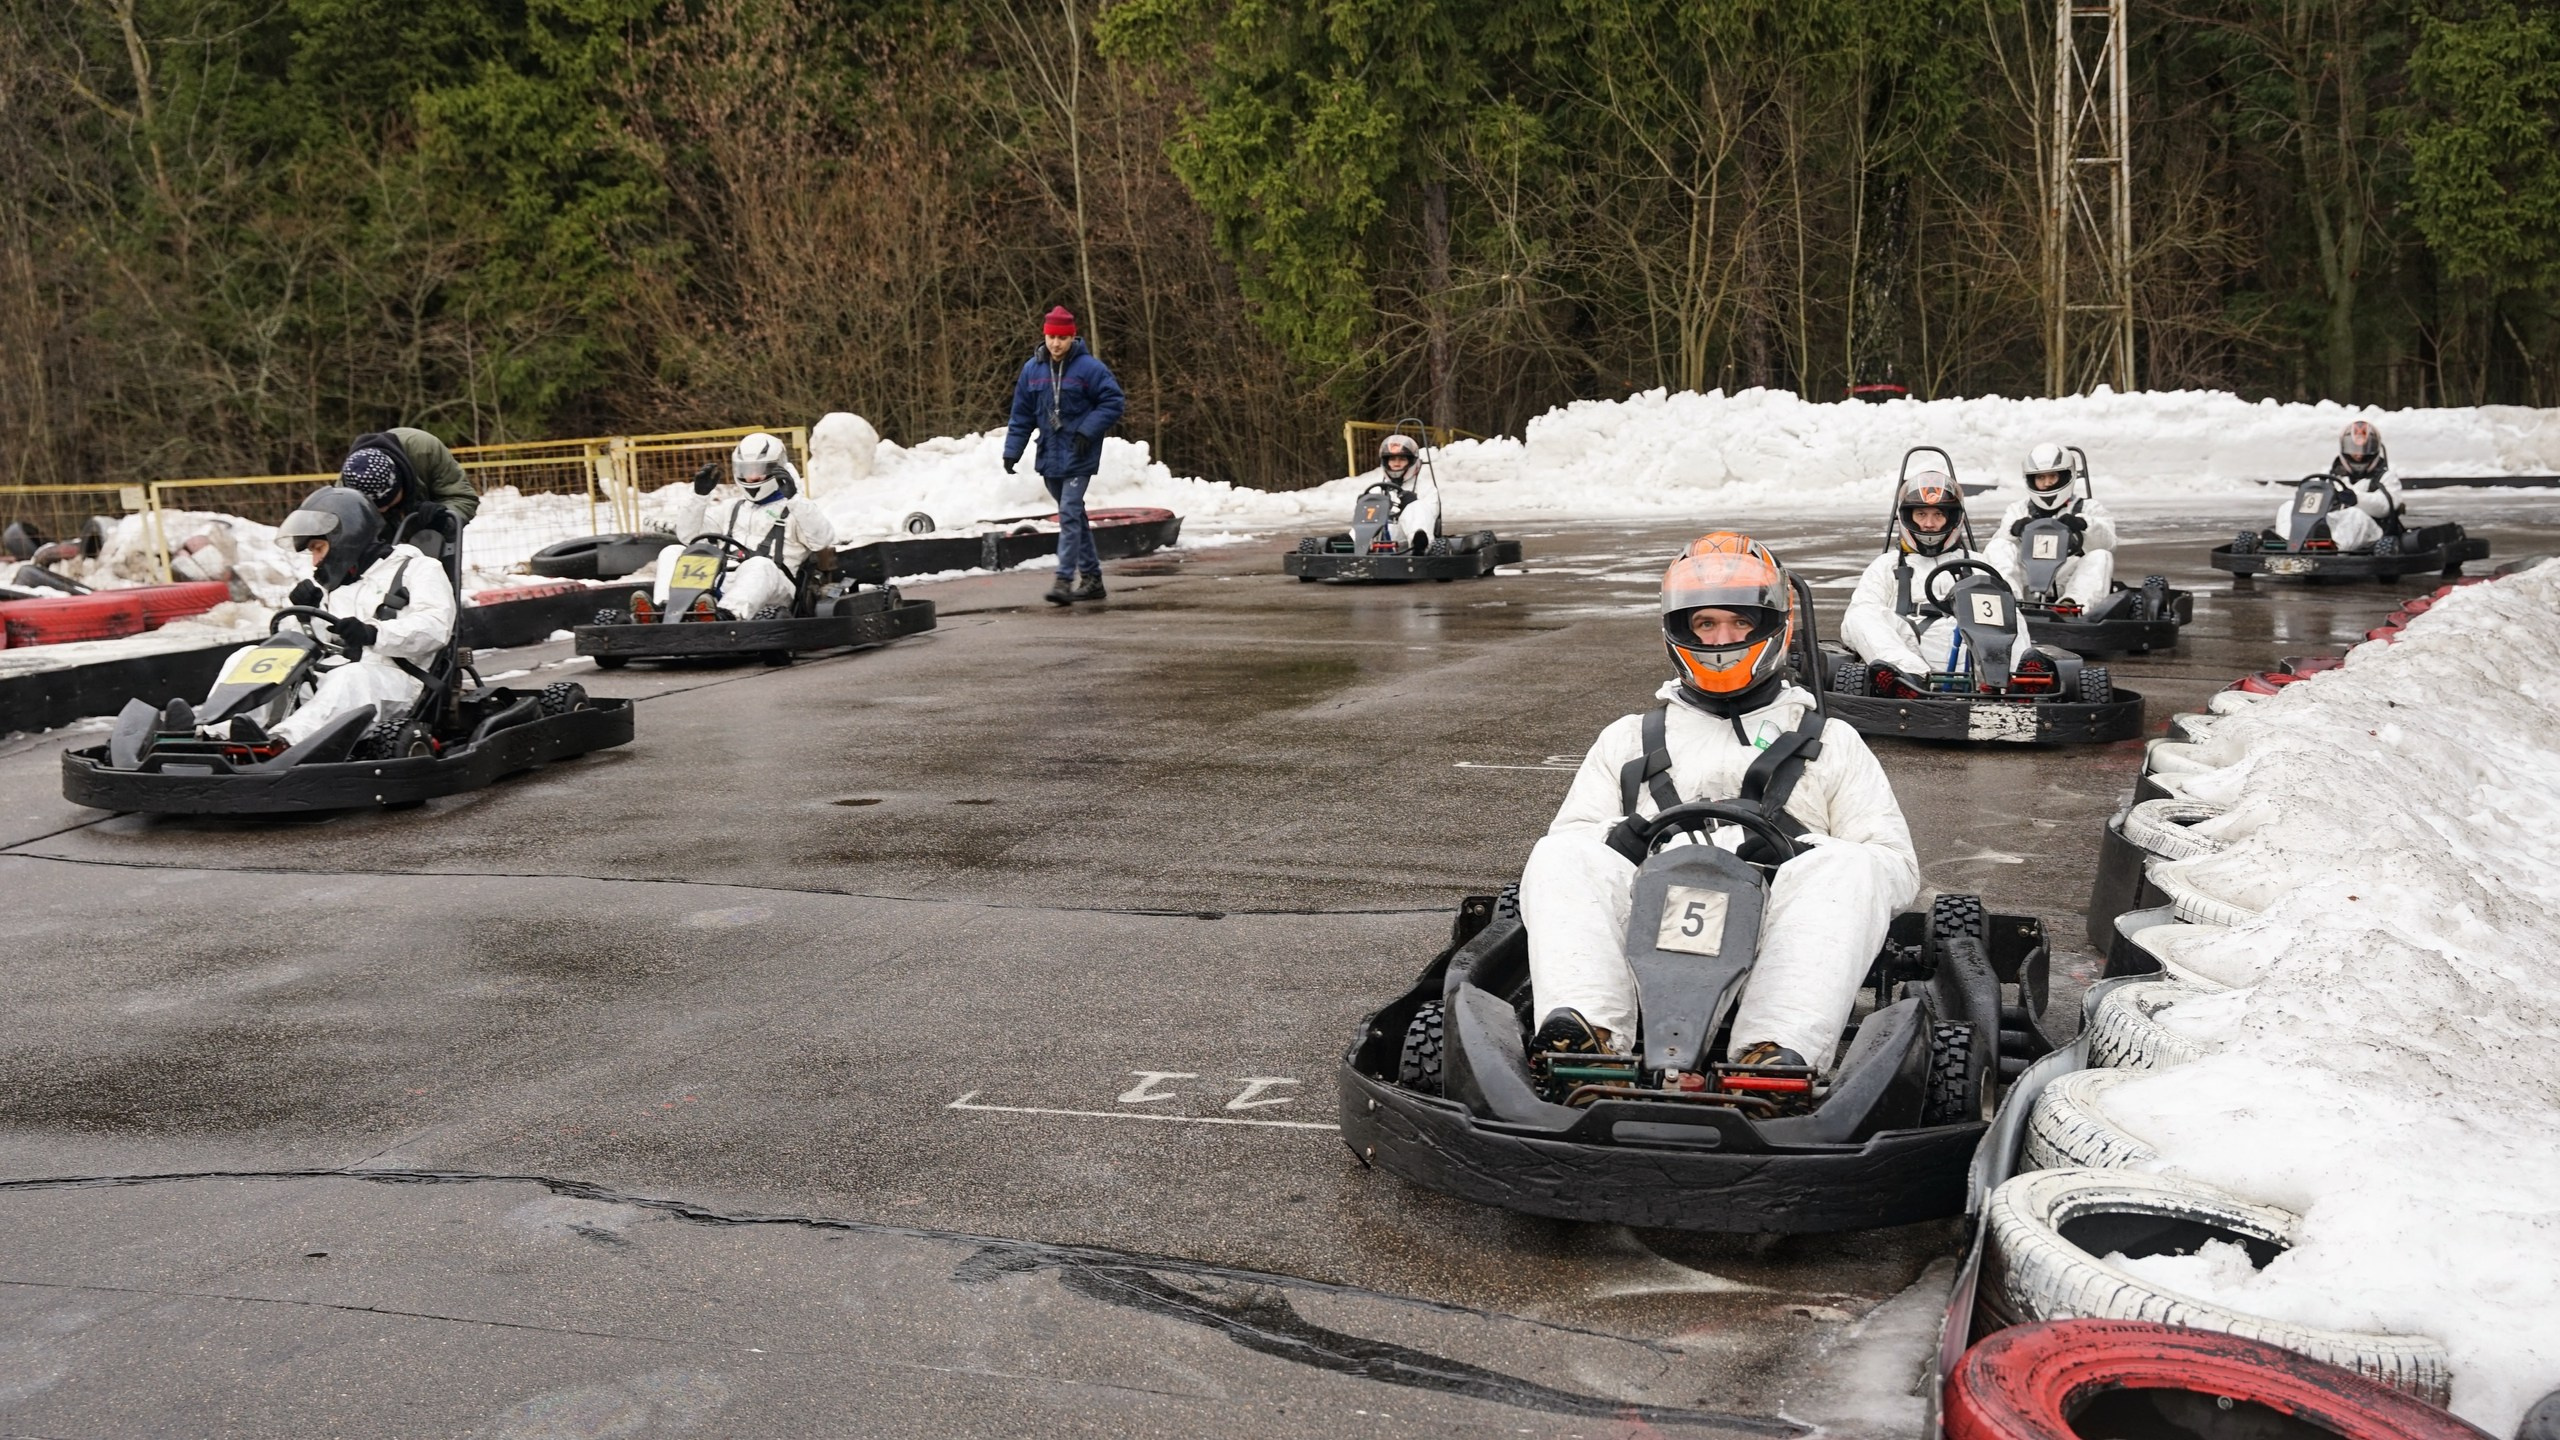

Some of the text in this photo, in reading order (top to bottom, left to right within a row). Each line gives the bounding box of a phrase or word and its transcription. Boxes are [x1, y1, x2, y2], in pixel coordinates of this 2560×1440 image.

[1366, 507, 1376, 519] 7
[2042, 540, 2049, 554] 1
[682, 564, 708, 580] 14
[1982, 600, 1993, 618] 3
[251, 657, 279, 673] 6
[1681, 901, 1706, 937] 5
